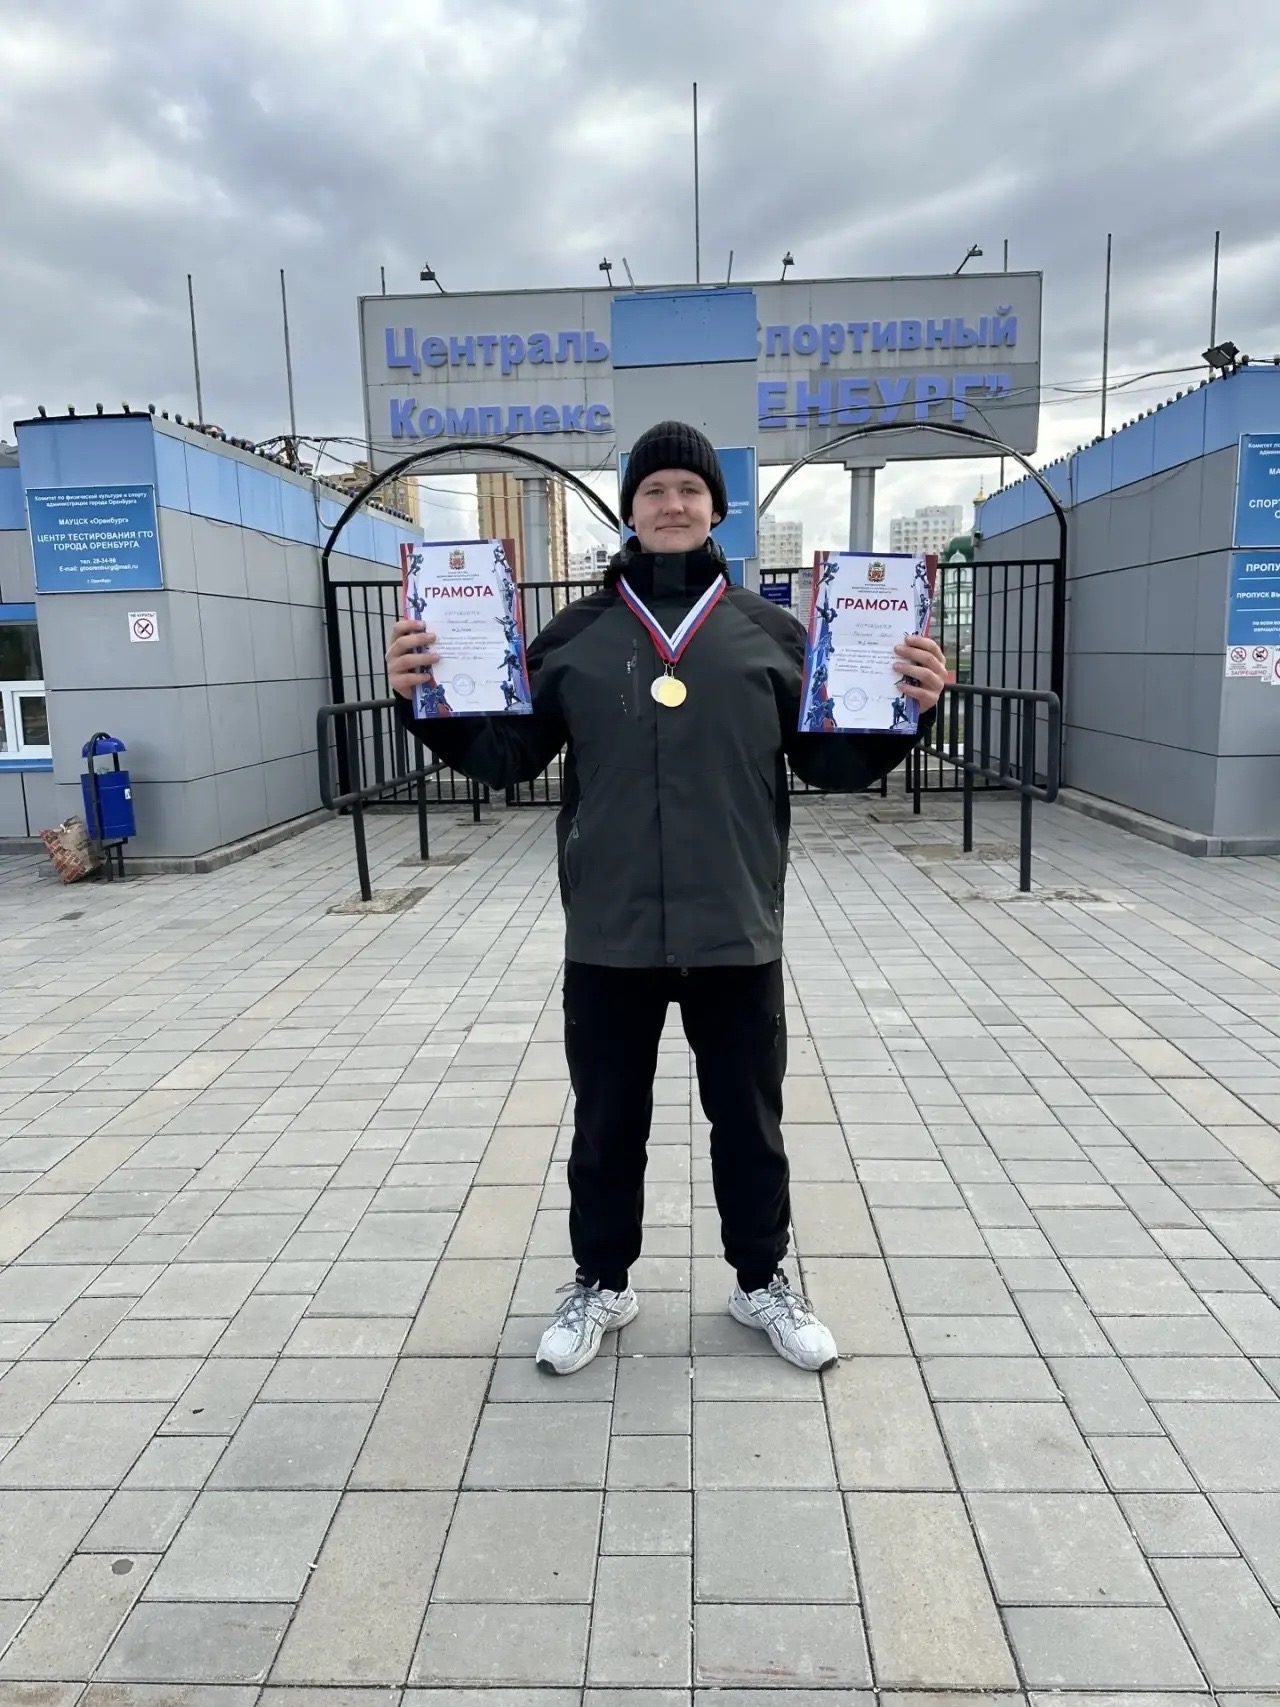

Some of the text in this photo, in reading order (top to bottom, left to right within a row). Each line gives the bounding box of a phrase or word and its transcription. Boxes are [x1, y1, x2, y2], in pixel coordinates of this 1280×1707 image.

[384, 304, 1018, 376] Централь портивный
[389, 397, 612, 439] Комплекс
[58, 518, 89, 526] МАУЦСК
[37, 530, 154, 543] ЦЕНТР ТЕСТИРОВАНИЯ ГТО
[53, 540, 140, 551] ГОРОДА ОРЕНБУРГА
[424, 585, 494, 599] ГРАМОТА
[836, 597, 909, 612] ГРАМОТА
